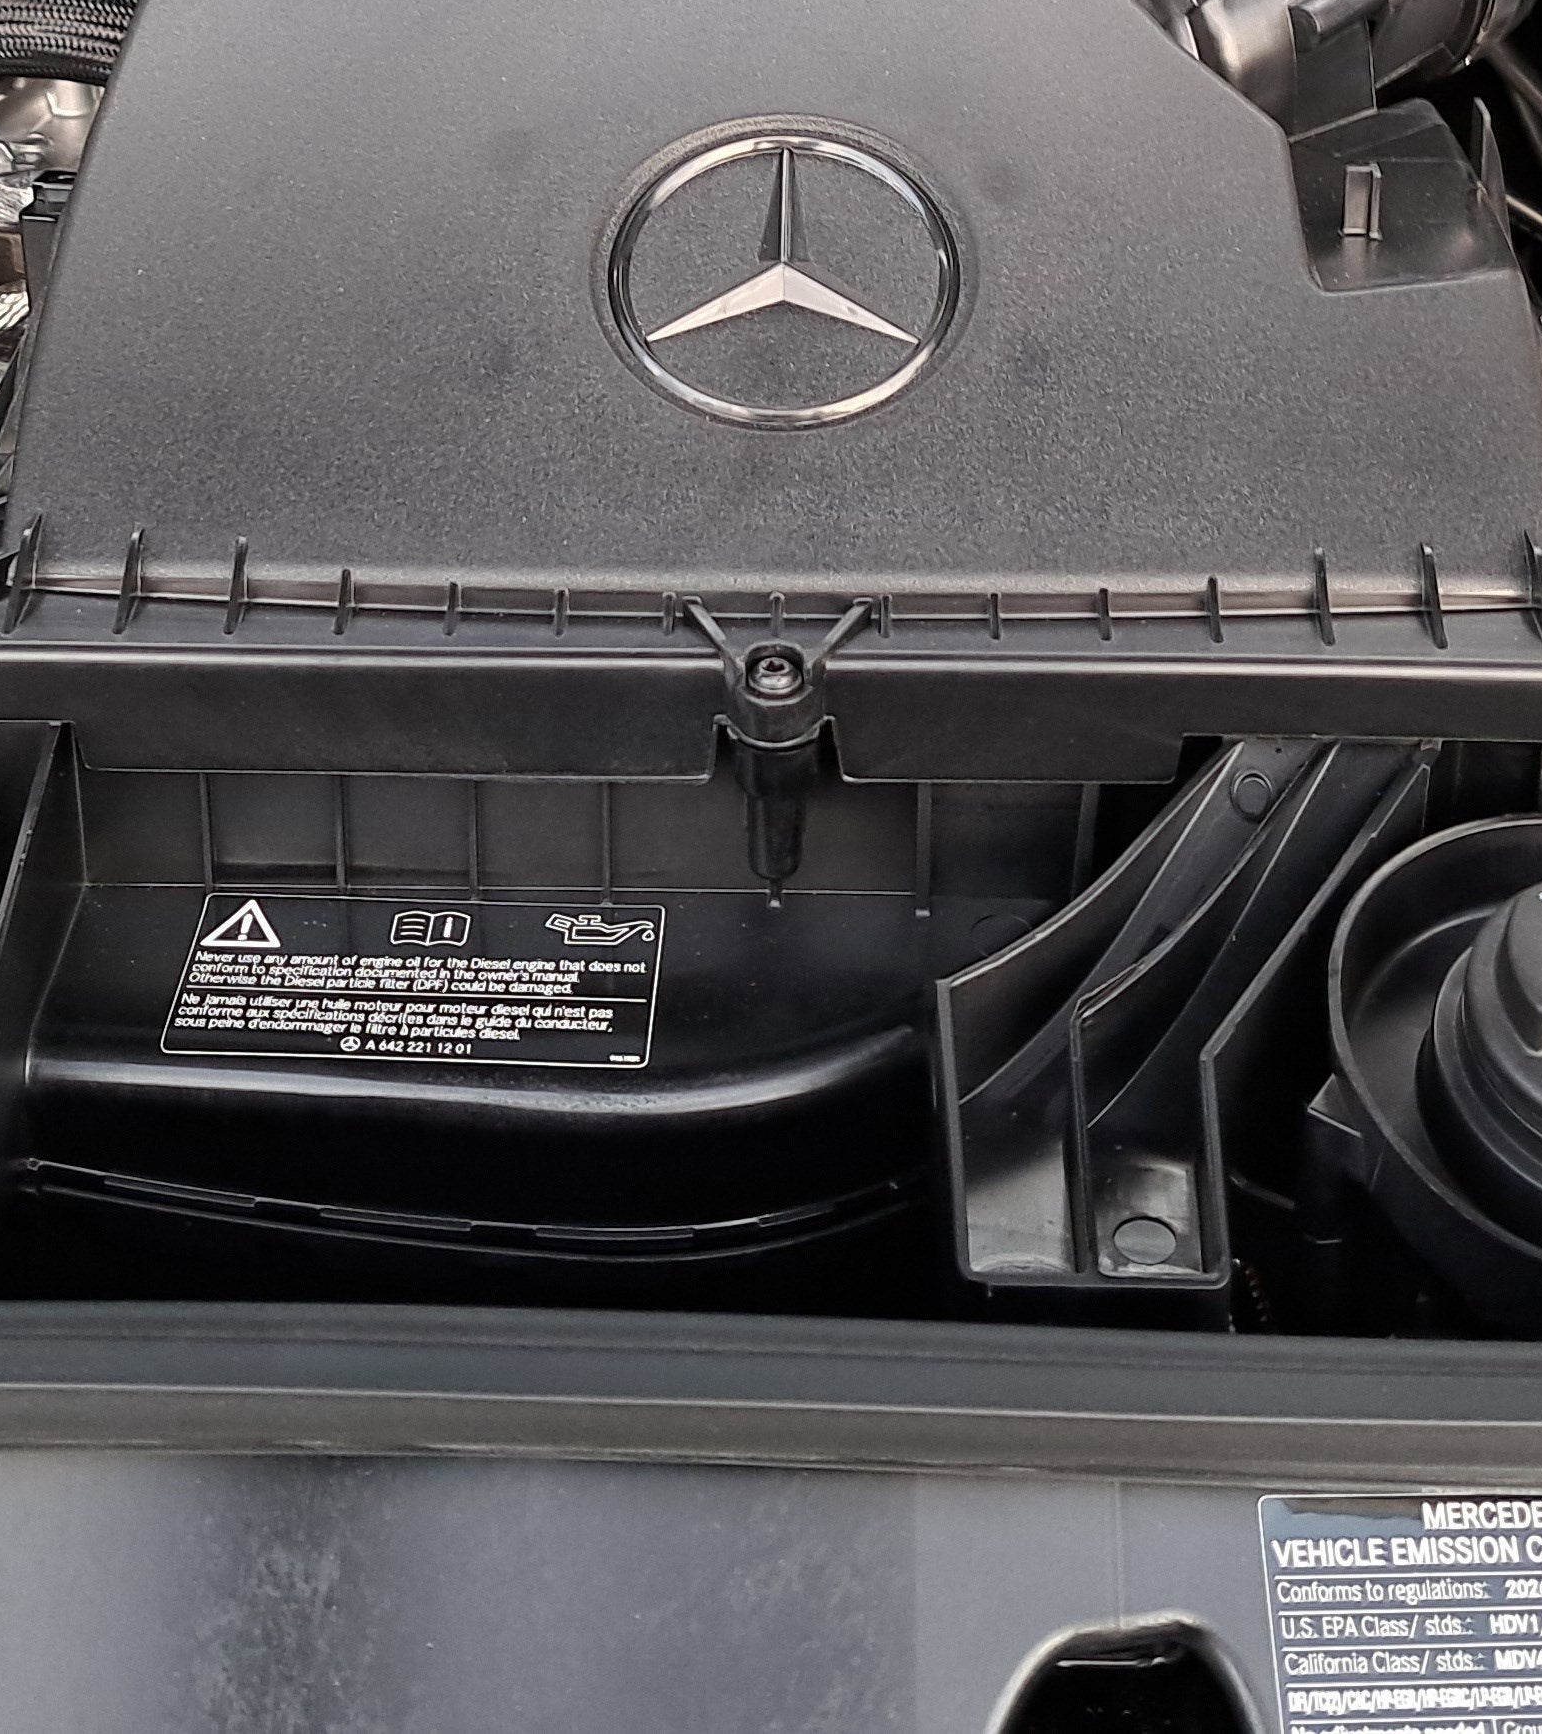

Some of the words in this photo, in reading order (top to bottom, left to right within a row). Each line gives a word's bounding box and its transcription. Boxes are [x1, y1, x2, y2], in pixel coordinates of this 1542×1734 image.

[195, 951, 235, 963] Never
[238, 955, 260, 964] use
[264, 955, 287, 967] any
[290, 955, 339, 965] amount
[343, 955, 357, 966] of
[360, 956, 403, 969] engine
[424, 957, 443, 968] for
[447, 958, 468, 969] the
[471, 959, 511, 970] Diesel
[512, 960, 556, 973] engine
[559, 961, 585, 972] that
[589, 962, 621, 973] does
[624, 963, 647, 973] not
[189, 973, 257, 985] Otherwise
[261, 975, 281, 985] the
[285, 975, 324, 987] Diesel
[327, 977, 375, 990] particle
[380, 978, 409, 989] filter
[414, 979, 449, 991] (DPF)
[451, 981, 486, 991] could
[489, 982, 506, 992] be
[440, 969, 451, 980] in
[454, 970, 475, 980] the
[178, 1006, 243, 1018] conforme
[246, 1010, 270, 1019] aux
[427, 1014, 457, 1026] dans
[475, 1017, 512, 1029] guide
[515, 1017, 532, 1028] du
[181, 993, 201, 1005] Ne
[205, 994, 247, 1008] jamais
[250, 996, 293, 1008] utiliser
[296, 1000, 319, 1009] une
[322, 998, 351, 1010] huile
[354, 1000, 403, 1011] moteur
[406, 1003, 437, 1015] pour
[439, 1003, 489, 1014] moteur
[491, 1004, 529, 1015] diesel
[533, 1006, 552, 1018] qui
[589, 1009, 613, 1020] pas
[175, 1019, 205, 1028] sous
[209, 1018, 245, 1031] peine
[366, 1024, 397, 1035] filtre
[411, 1027, 476, 1039] particules
[366, 1040, 375, 1050] A
[379, 1041, 403, 1052] 642
[407, 1042, 431, 1053] 221
[438, 1043, 453, 1054] 12
[455, 1043, 472, 1054] 01
[1272, 1537, 1387, 1568] VEHICLE
[1391, 1536, 1523, 1566] EMISSION
[1277, 1581, 1361, 1602] Conforms
[1365, 1580, 1384, 1601] to
[1388, 1579, 1489, 1605] regulations:
[1281, 1617, 1319, 1639] U.S.
[1323, 1616, 1359, 1638] EPA
[1362, 1615, 1419, 1639] Class/
[1284, 1652, 1367, 1675] California
[1373, 1651, 1429, 1675] Class/
